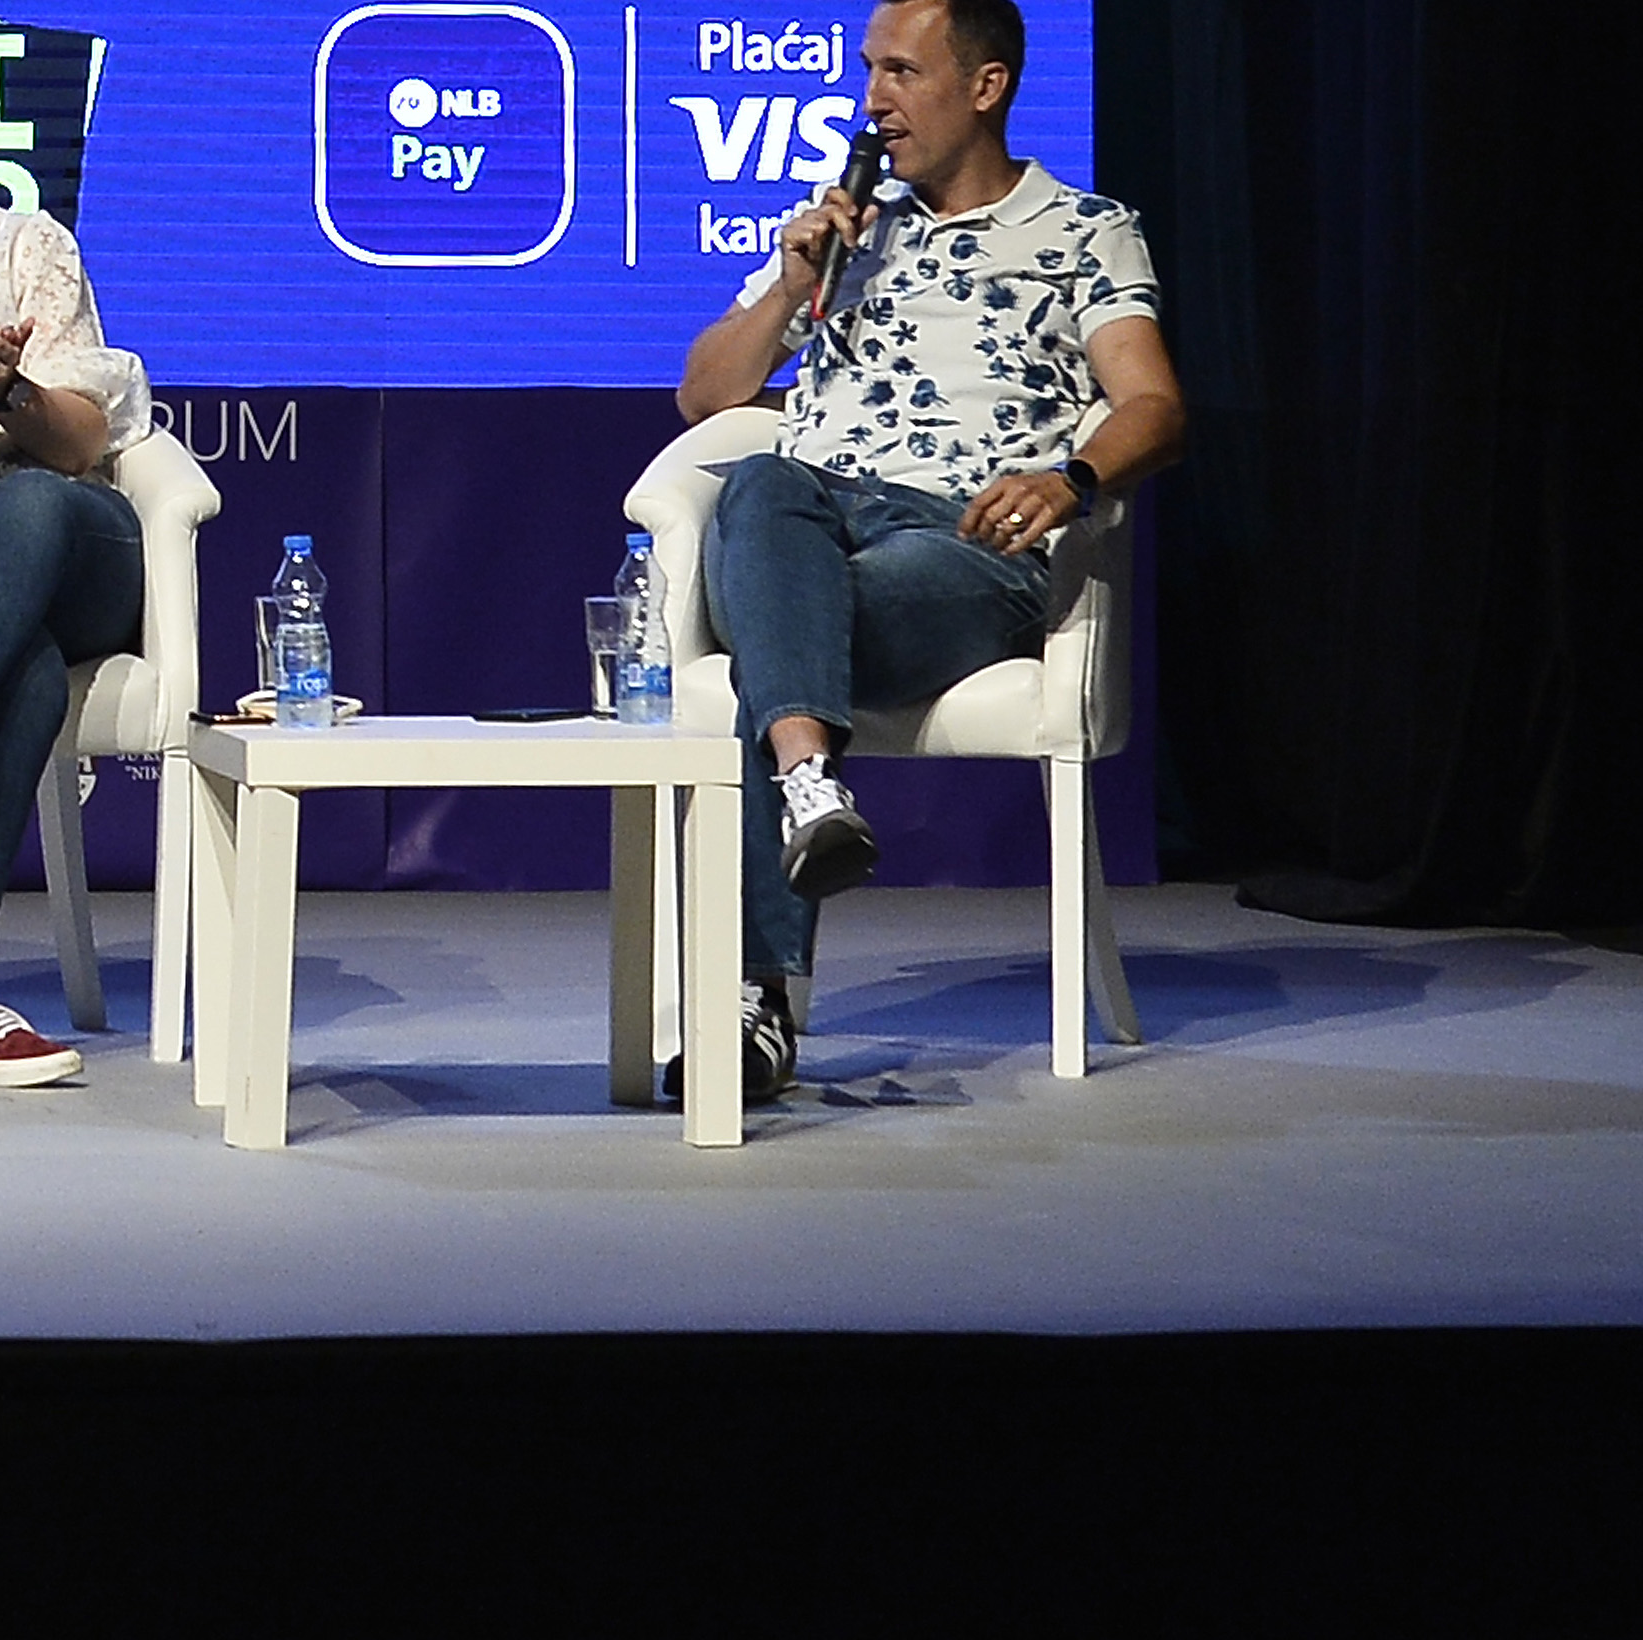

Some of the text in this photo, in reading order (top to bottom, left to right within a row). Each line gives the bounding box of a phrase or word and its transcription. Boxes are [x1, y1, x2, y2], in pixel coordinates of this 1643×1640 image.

[699, 20, 844, 84] Plaćaj
[442, 89, 501, 118] NLB
[391, 135, 485, 191] Pay
[669, 96, 891, 182] VIS
